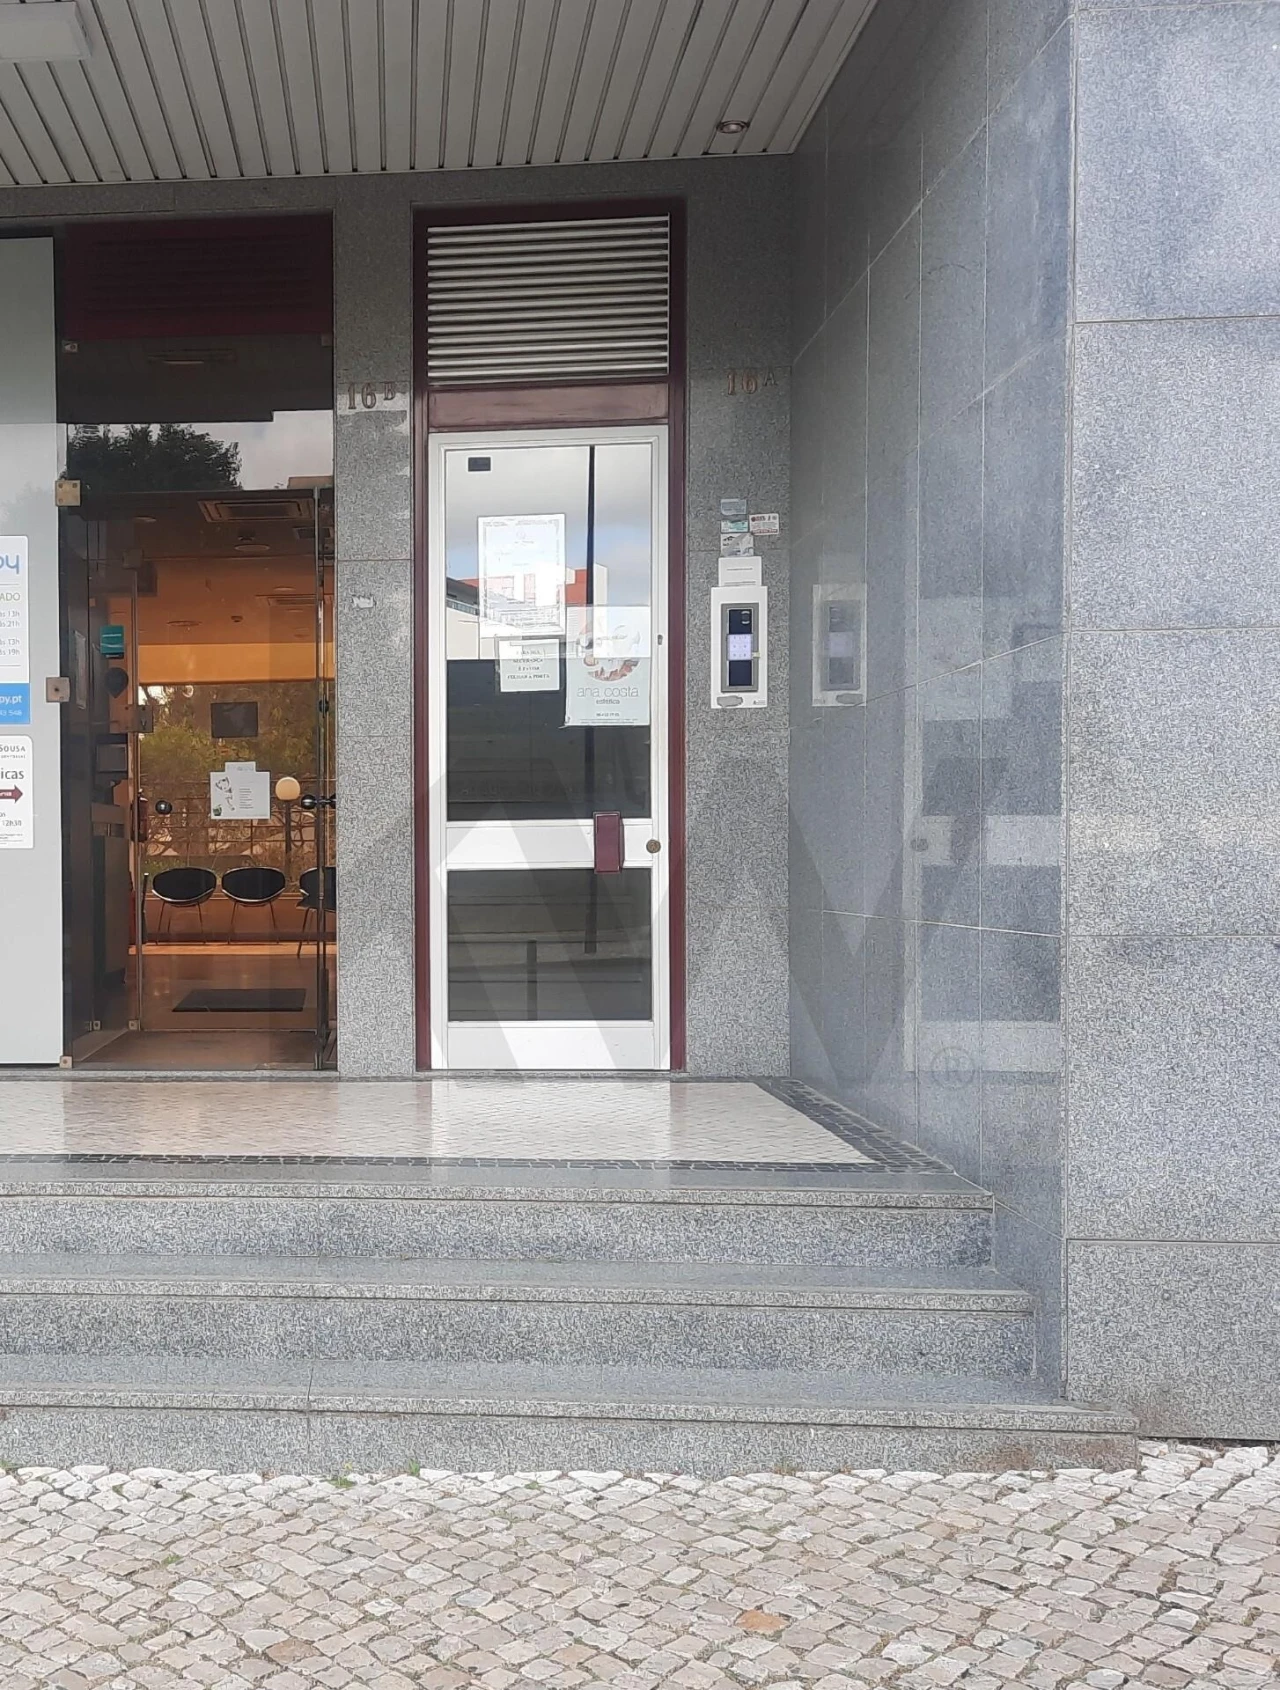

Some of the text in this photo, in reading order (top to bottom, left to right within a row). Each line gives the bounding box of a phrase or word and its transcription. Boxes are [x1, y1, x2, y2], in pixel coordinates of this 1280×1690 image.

[347, 382, 377, 410] 16
[727, 371, 779, 396] 16 A
[577, 685, 639, 698] ana costa
